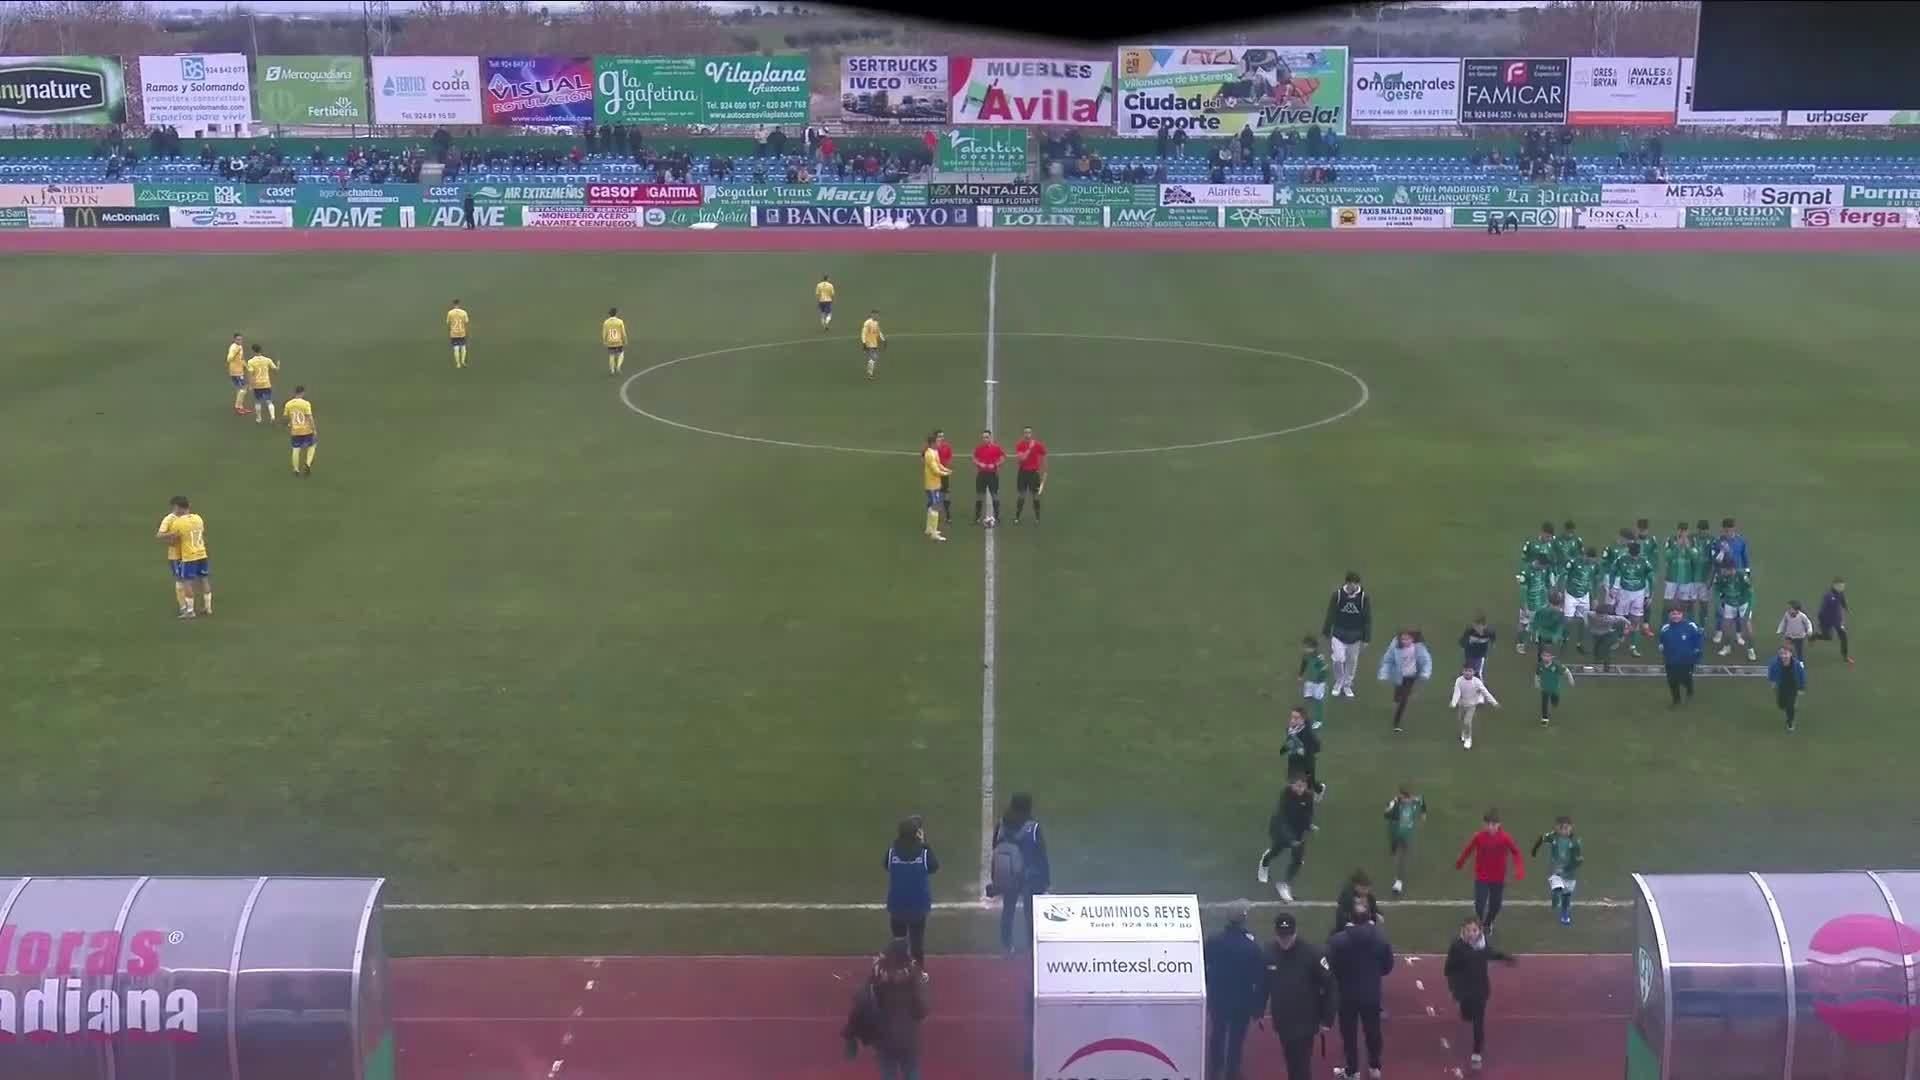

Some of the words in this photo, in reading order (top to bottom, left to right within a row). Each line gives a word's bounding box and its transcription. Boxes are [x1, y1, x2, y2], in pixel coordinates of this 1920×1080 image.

[849, 59, 937, 72] SERTRUCKS
[987, 62, 1092, 78] MUEBLES
[281, 68, 352, 81] Mercoguadiana
[623, 69, 640, 87] la
[705, 61, 806, 92] Vilaplana
[1632, 68, 1666, 77] AVALES
[432, 78, 470, 90] coda
[850, 77, 901, 89] IVECO
[1124, 78, 1173, 88] Villanueva
[1175, 76, 1187, 84] de
[1201, 72, 1233, 82] Serena
[1357, 76, 1456, 91] Ornamentales
[1631, 77, 1672, 86] FIANZAS
[146, 83, 178, 92] Ramos
[181, 84, 188, 94] y
[191, 82, 245, 92] Solomando
[490, 74, 591, 101] VISUAL
[752, 83, 800, 95] Autocares
[625, 82, 699, 110] gafetina
[1124, 92, 1202, 110] Ciudad
[1203, 99, 1219, 108] del
[1387, 90, 1424, 102] oeste
[1467, 86, 1561, 104] FAMICAR
[151, 113, 192, 122] Espacios
[308, 105, 358, 117] Fertiberia
[1807, 110, 1868, 123] urbaser
[1131, 113, 1220, 130] Deporte
[266, 187, 297, 197] caser
[430, 186, 459, 196] caser
[504, 187, 522, 199] MR
[523, 184, 585, 199] EXTREMEÑAS
[590, 186, 638, 197] casor
[717, 186, 768, 200] Segador
[773, 186, 812, 197] Trans
[817, 186, 875, 204] Macy
[955, 184, 1039, 195] MONTAJEX
[1071, 184, 1130, 194] POLICLÍNICA
[1208, 187, 1240, 197] Alarife
[1410, 184, 1436, 193] PEÑA
[1439, 185, 1499, 193] MADRIDISTA
[1666, 185, 1724, 197] METASA
[156, 189, 209, 202] Kappa
[1296, 194, 1344, 206] ACQUA
[1355, 194, 1384, 204] ZOO
[1760, 187, 1832, 205] Samat
[432, 206, 505, 227] ADME
[787, 207, 864, 225] BANCA
[872, 207, 948, 225] PUEYO
[1472, 211, 1536, 223] SPAR
[1690, 206, 1786, 217] SEGURDON
[1840, 208, 1900, 227] ferga
[579, 219, 637, 227] CIENFUEGOS
[1080, 905, 1150, 919] ALUMINIOS
[1154, 905, 1191, 919] REYES
[1047, 957, 1193, 973] www.imtexsl.com
